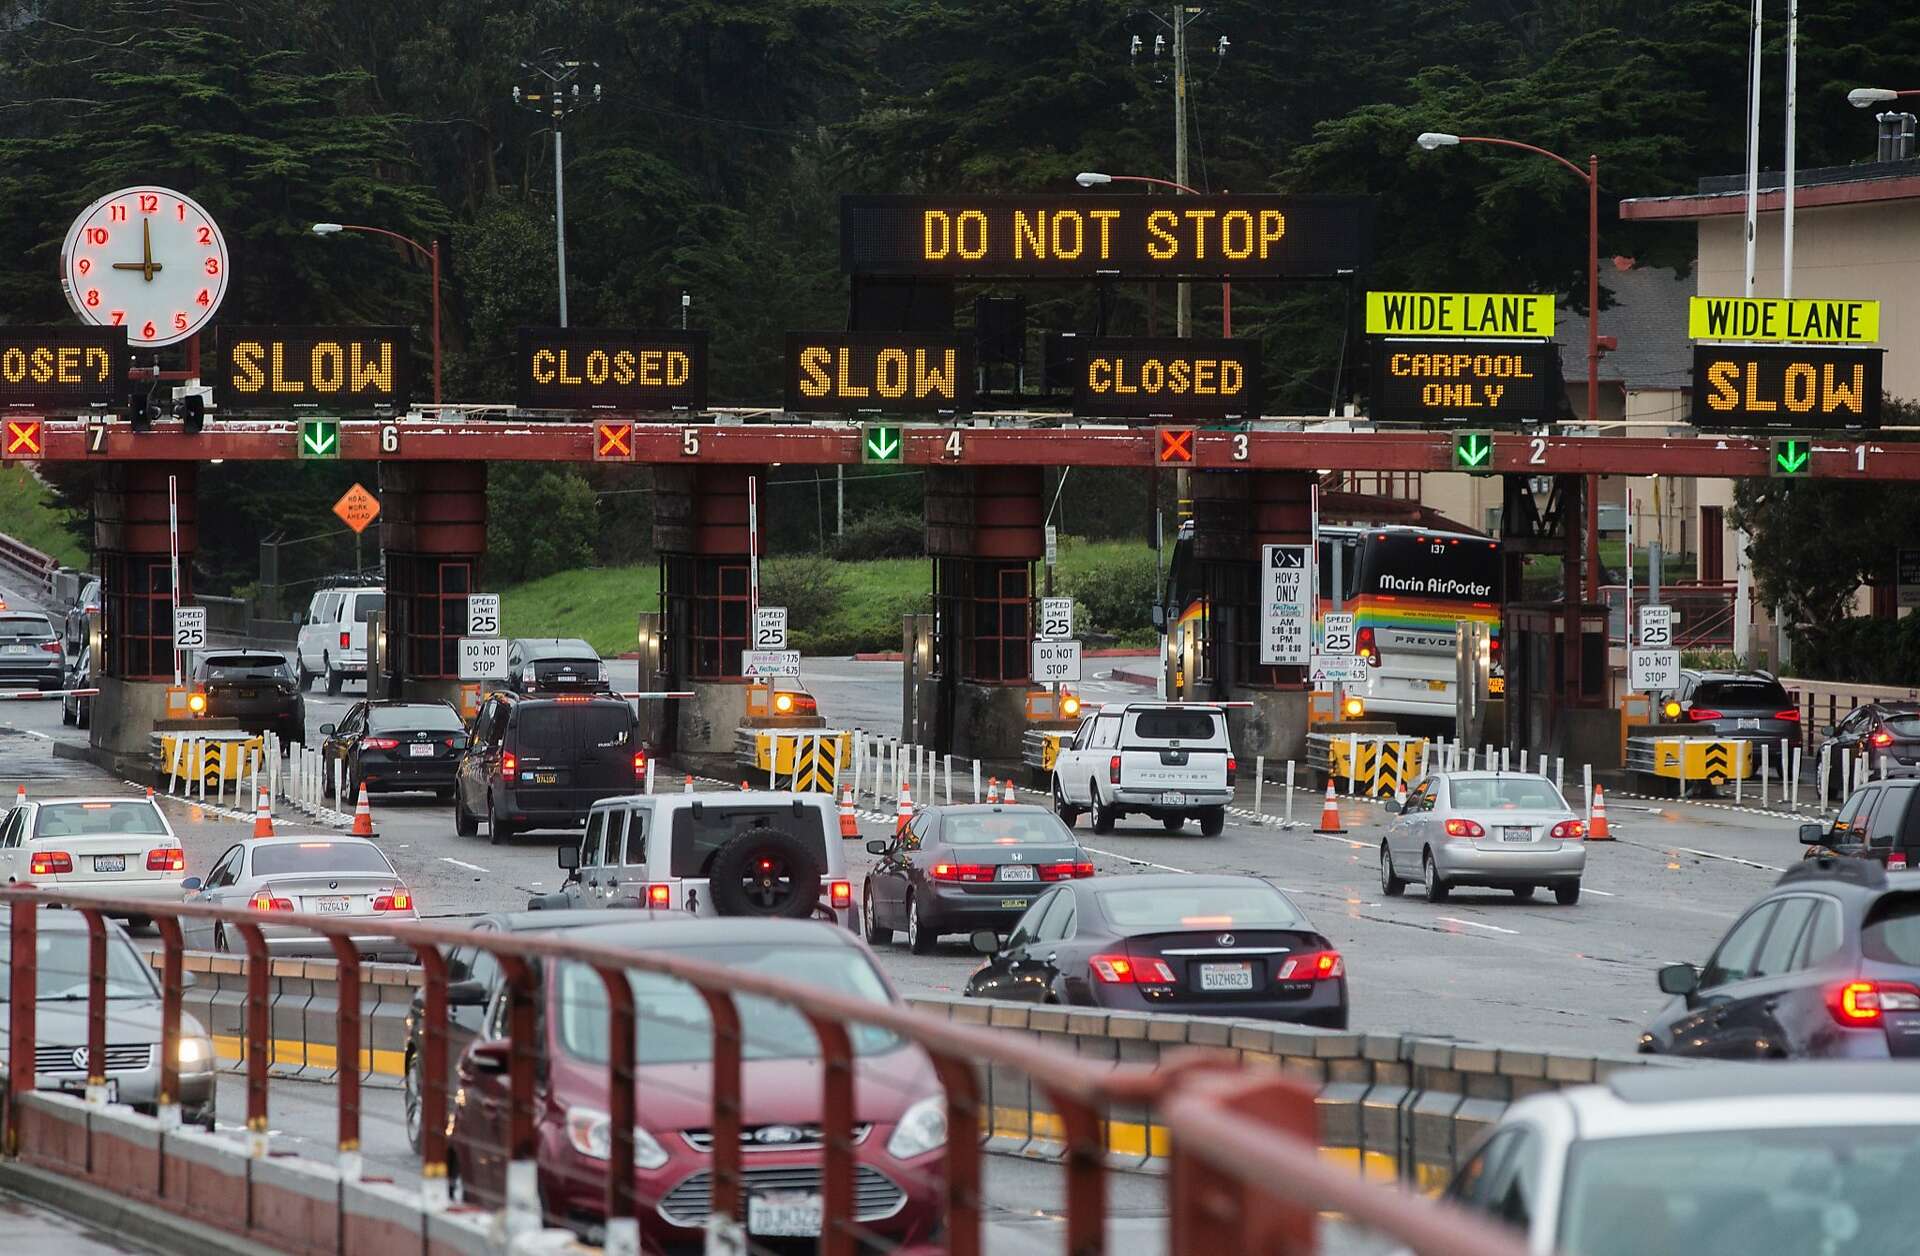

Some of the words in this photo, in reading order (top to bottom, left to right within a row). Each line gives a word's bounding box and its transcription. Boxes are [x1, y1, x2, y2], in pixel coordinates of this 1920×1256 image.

[139, 195, 158, 211] 12
[111, 205, 126, 221] 11
[177, 204, 185, 220] 1
[87, 228, 108, 245] 10
[197, 227, 211, 245] 2
[925, 211, 987, 259] DO
[1015, 211, 1120, 259] NOT
[1148, 211, 1285, 259] STOP
[79, 259, 91, 274] 9
[206, 258, 219, 274] 3
[87, 290, 99, 306] 8
[196, 290, 209, 306] 4
[112, 312, 123, 326] 7
[175, 312, 187, 329] 5
[1384, 296, 1452, 330] WIDE
[1463, 298, 1537, 332] LANE
[1707, 301, 1774, 335] WIDE
[1784, 302, 1862, 338] LANE
[143, 322, 155, 338] 6
[233, 342, 392, 392] SLOW
[533, 349, 689, 385] CLOSED
[800, 347, 955, 398] SLOW
[1391, 353, 1534, 378] CARPOOL
[1089, 358, 1243, 395] CLOSED
[1707, 361, 1864, 413] SLOW
[1423, 383, 1504, 408] ONLY
[90, 425, 104, 451] 7
[383, 425, 398, 452] 6
[684, 429, 698, 454] 5
[945, 431, 962, 456] 4
[1233, 434, 1248, 459] 3
[1531, 438, 1546, 464] 2
[1855, 444, 1866, 471] 1
[1430, 543, 1445, 554] 137
[1275, 572, 1292, 584] HOV
[1294, 572, 1300, 584] 3
[1379, 574, 1424, 592] Marin
[1427, 577, 1491, 597] AirPorter
[1276, 585, 1298, 602] ONLY
[470, 598, 497, 606] SPEED
[1044, 601, 1070, 610] SPEED
[176, 611, 204, 619] SPEED
[473, 607, 494, 615] LIMIT
[759, 611, 784, 619] SPEED
[1643, 609, 1669, 617] SPEED
[179, 620, 201, 628] LIMIT
[471, 616, 497, 632] 25
[1045, 619, 1070, 635] 25
[1280, 618, 1294, 626] AM
[177, 629, 203, 645] 25
[759, 629, 783, 645] 25
[1279, 635, 1293, 643] PM
[1326, 634, 1351, 650] 25
[1395, 635, 1456, 647] PREVOS
[1643, 627, 1669, 643] 25
[466, 645, 479, 656] DO
[483, 645, 501, 656] NOT
[1040, 648, 1053, 660] DO
[1056, 648, 1073, 659] NOT
[472, 661, 496, 672] STOP
[1046, 664, 1068, 675] STOP
[1639, 656, 1651, 667] DO
[1655, 656, 1672, 667] NOT
[1645, 671, 1667, 682] STOP
